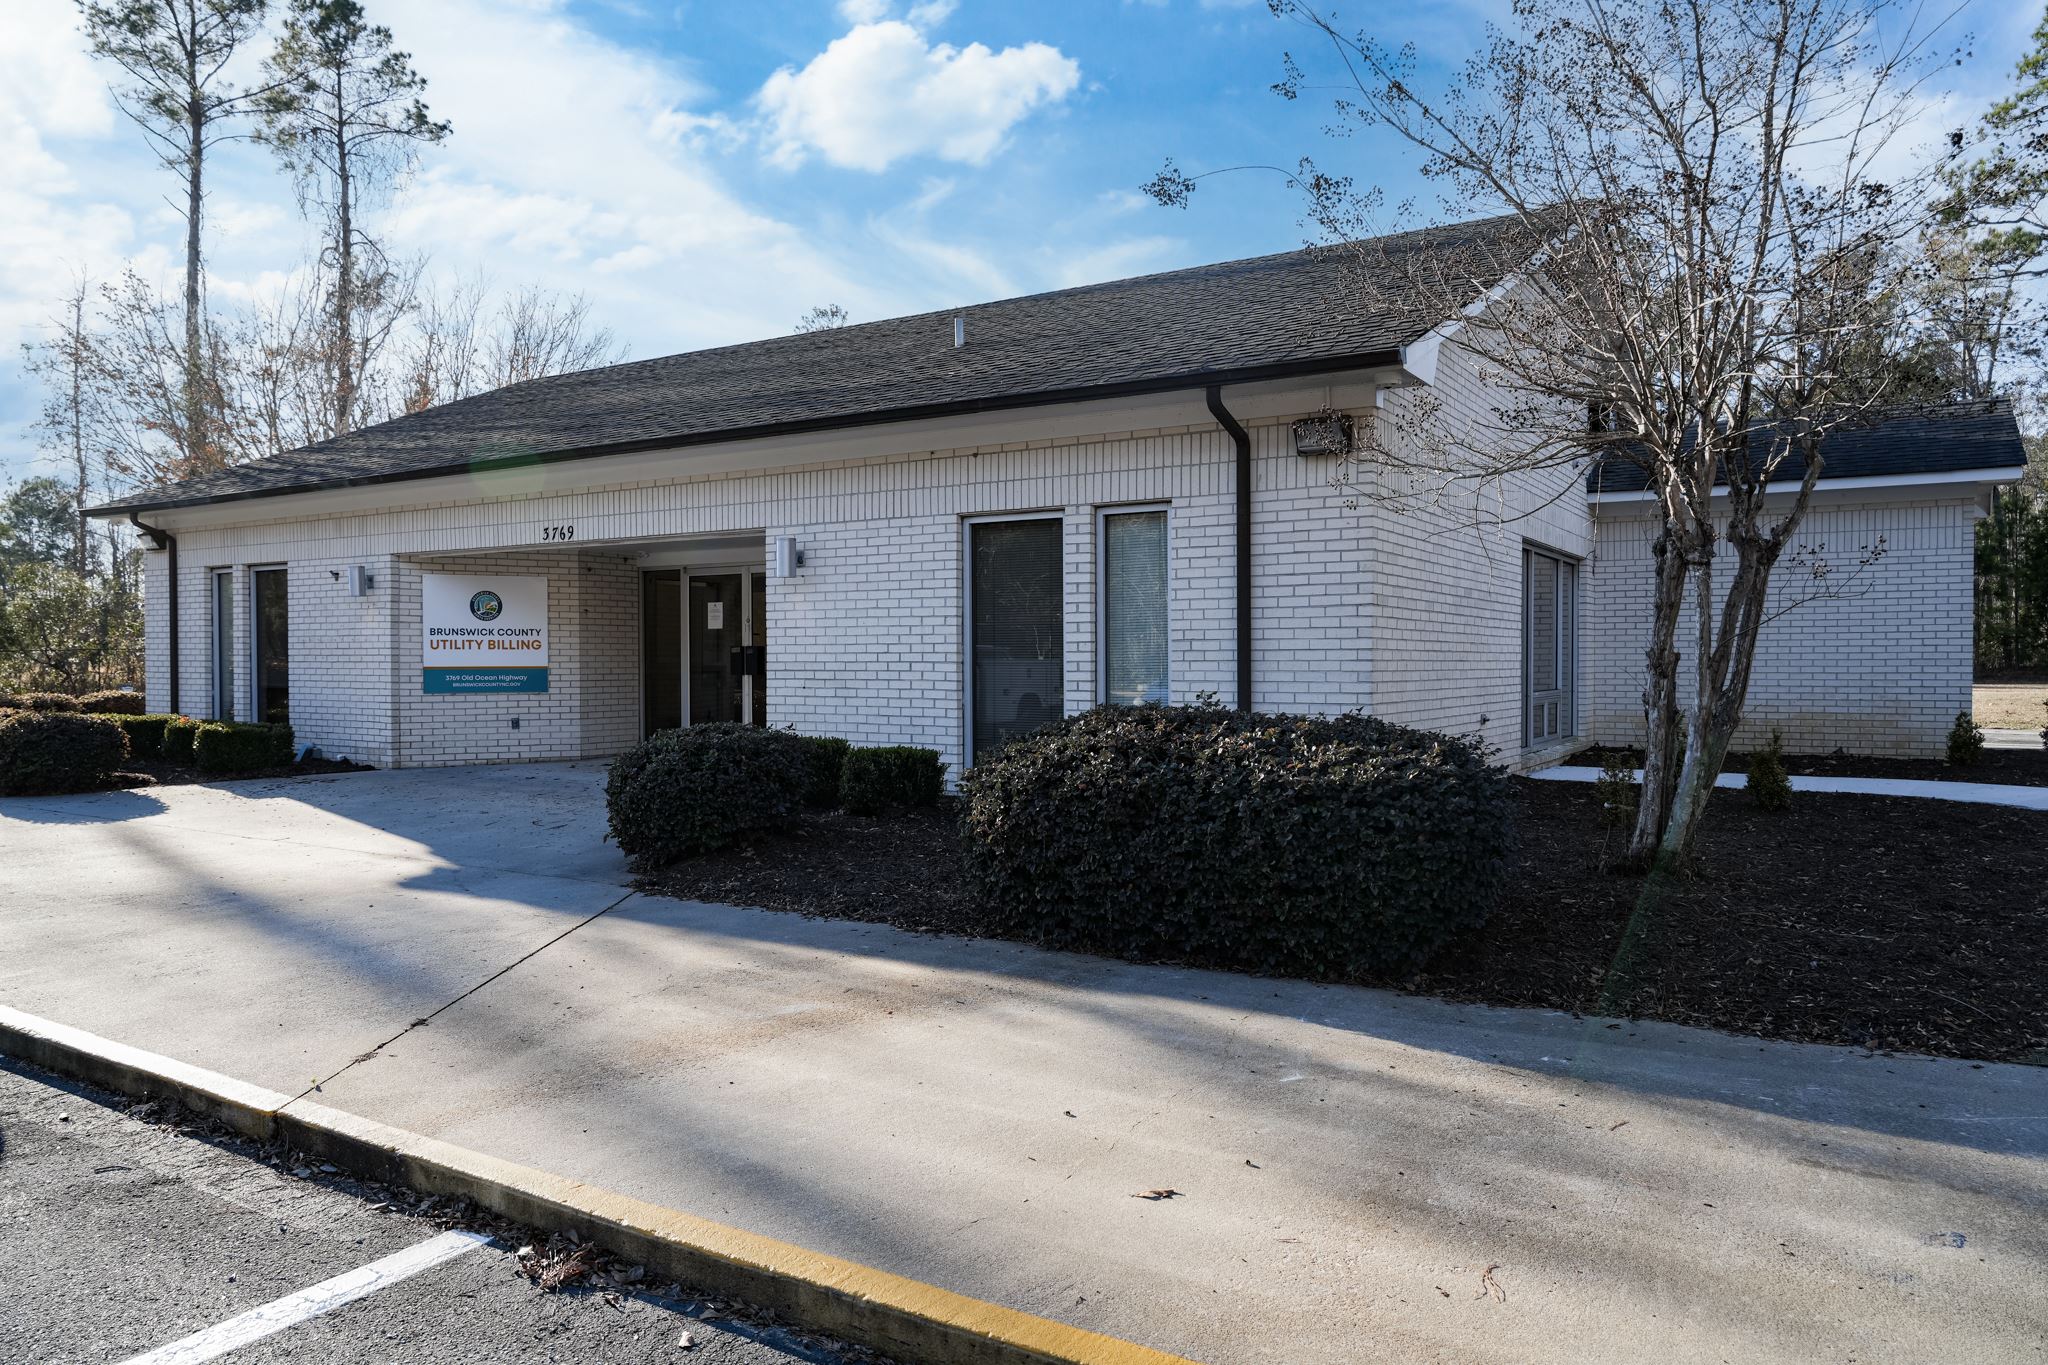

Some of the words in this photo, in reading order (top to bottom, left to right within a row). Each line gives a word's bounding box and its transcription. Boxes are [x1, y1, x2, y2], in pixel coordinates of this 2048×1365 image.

[542, 524, 574, 541] 3769
[429, 627, 495, 636] BRUNSWICK
[497, 628, 542, 637] COUNTY
[430, 639, 484, 650] UTILITY
[487, 639, 542, 650] BILLING
[498, 674, 528, 682] Highway
